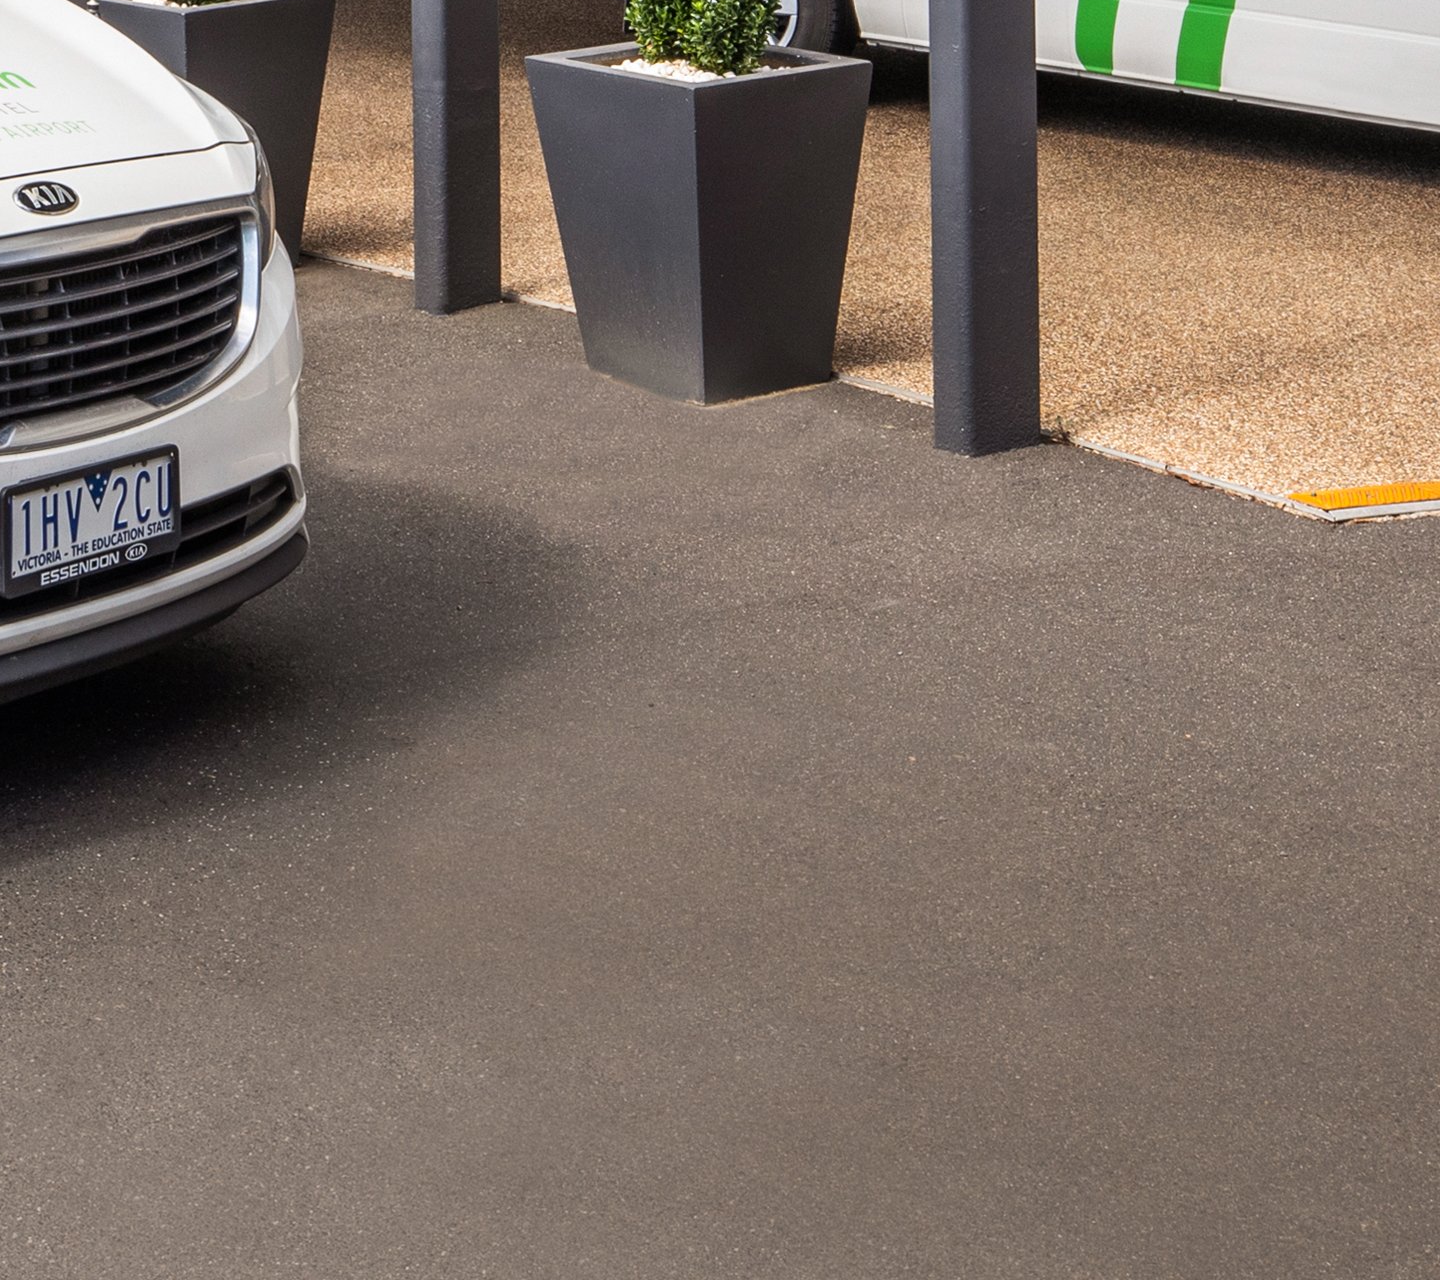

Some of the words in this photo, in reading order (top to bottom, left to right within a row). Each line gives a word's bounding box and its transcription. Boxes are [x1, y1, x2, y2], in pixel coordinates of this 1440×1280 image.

[2, 120, 98, 139] AIRPORT
[21, 184, 75, 209] KIA
[17, 548, 62, 572] VICTORIA
[71, 541, 89, 557] THE
[91, 528, 145, 551] EDUCATION
[147, 519, 171, 537] STATE
[40, 550, 120, 586] ESSENDON
